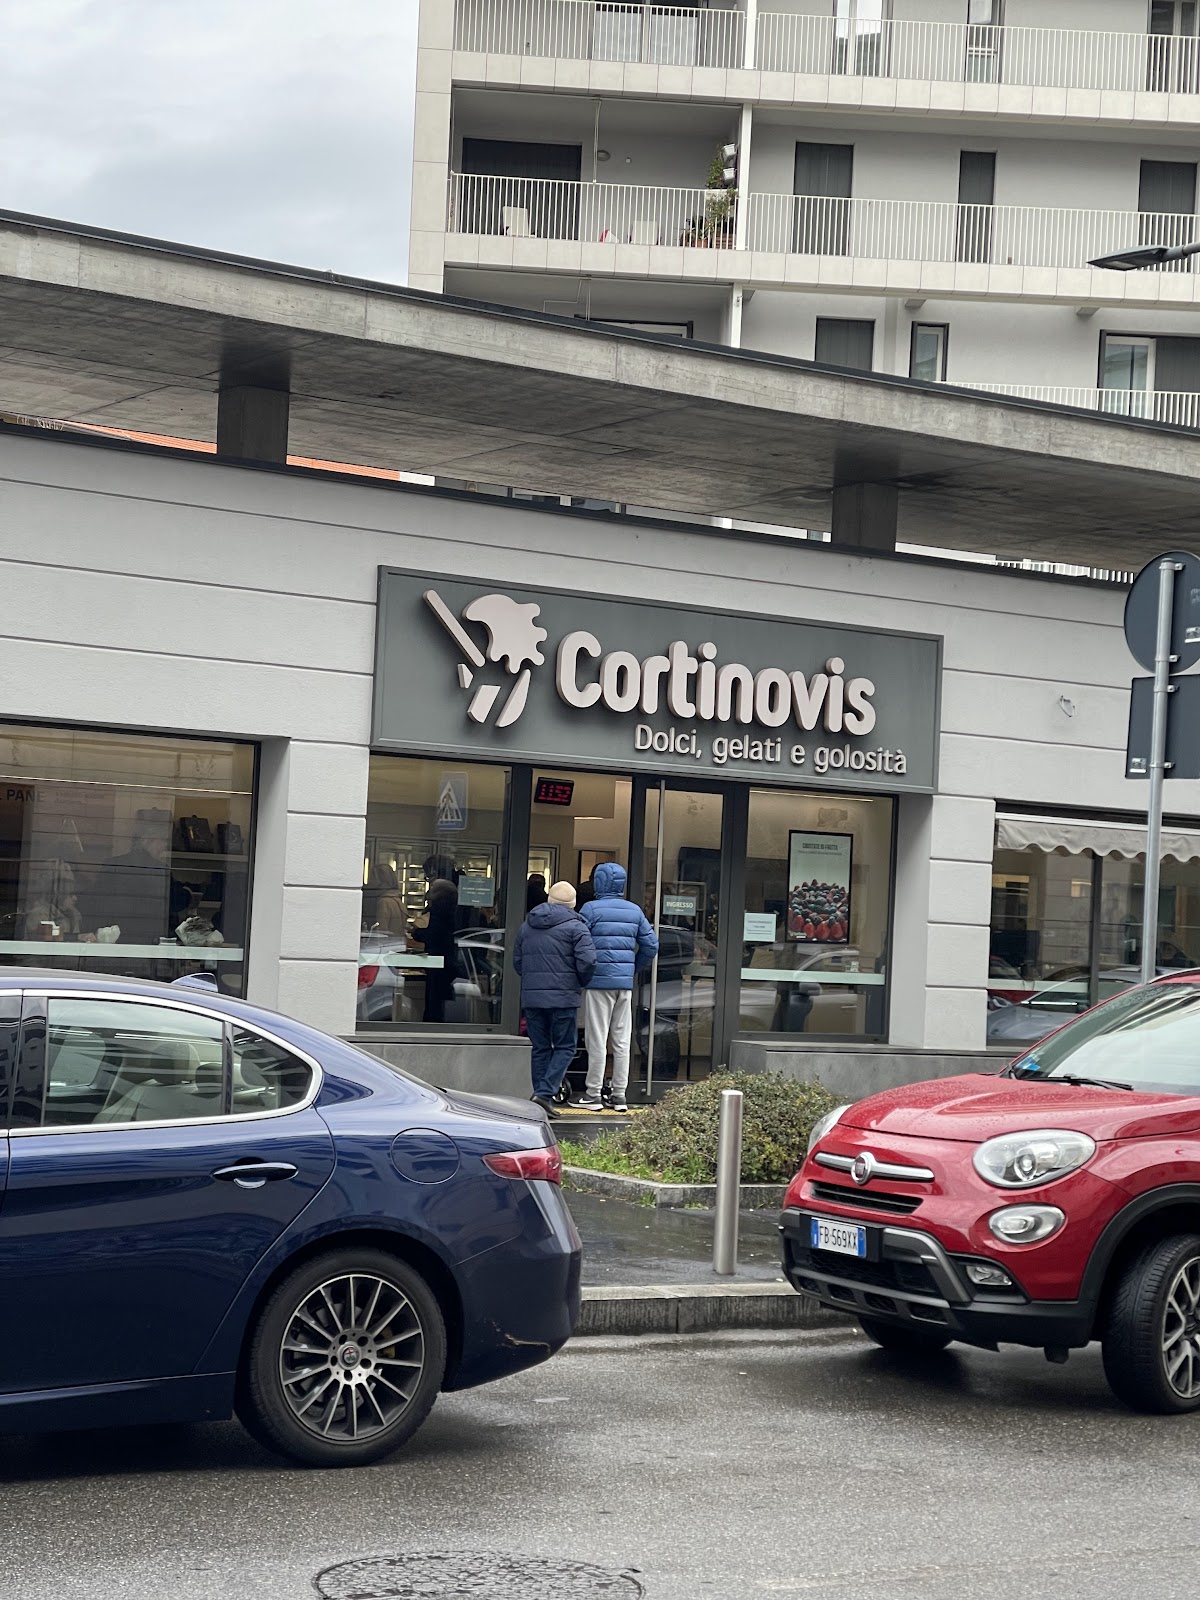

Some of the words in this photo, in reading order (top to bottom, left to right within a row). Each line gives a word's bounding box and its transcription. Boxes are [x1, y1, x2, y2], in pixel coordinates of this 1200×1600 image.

[556, 631, 876, 736] Cortinovis
[634, 724, 702, 758] Dolci,
[712, 734, 781, 764] gelati
[790, 744, 805, 764] e
[813, 743, 907, 774] golosità
[666, 901, 694, 909] INGRESSO
